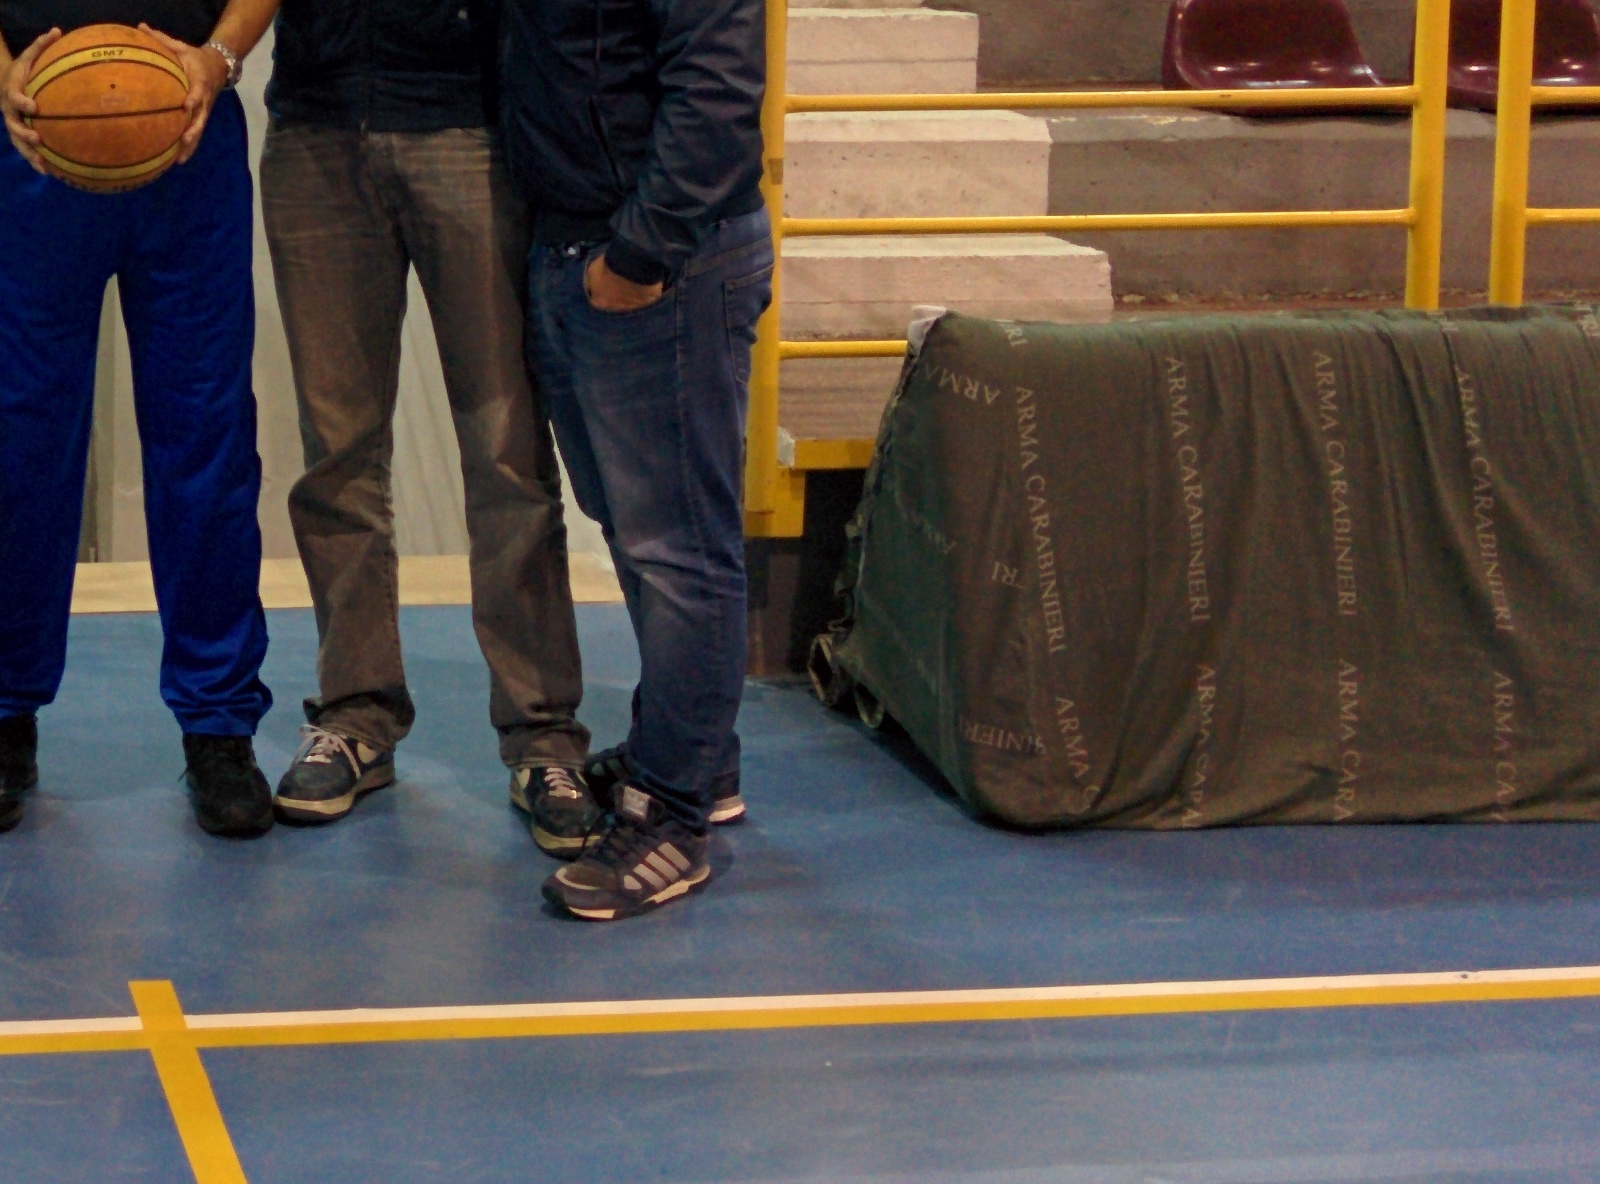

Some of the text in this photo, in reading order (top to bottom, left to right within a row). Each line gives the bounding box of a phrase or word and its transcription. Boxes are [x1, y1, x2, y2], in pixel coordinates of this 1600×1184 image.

[1016, 386, 1068, 655] ARMA CARABINIERI
[1165, 355, 1211, 622] ARMA CARABINIERI
[1314, 350, 1357, 616] ARMA CARABINIERI
[1056, 697, 1090, 779] ARMA
[1337, 658, 1359, 741] ARMA
